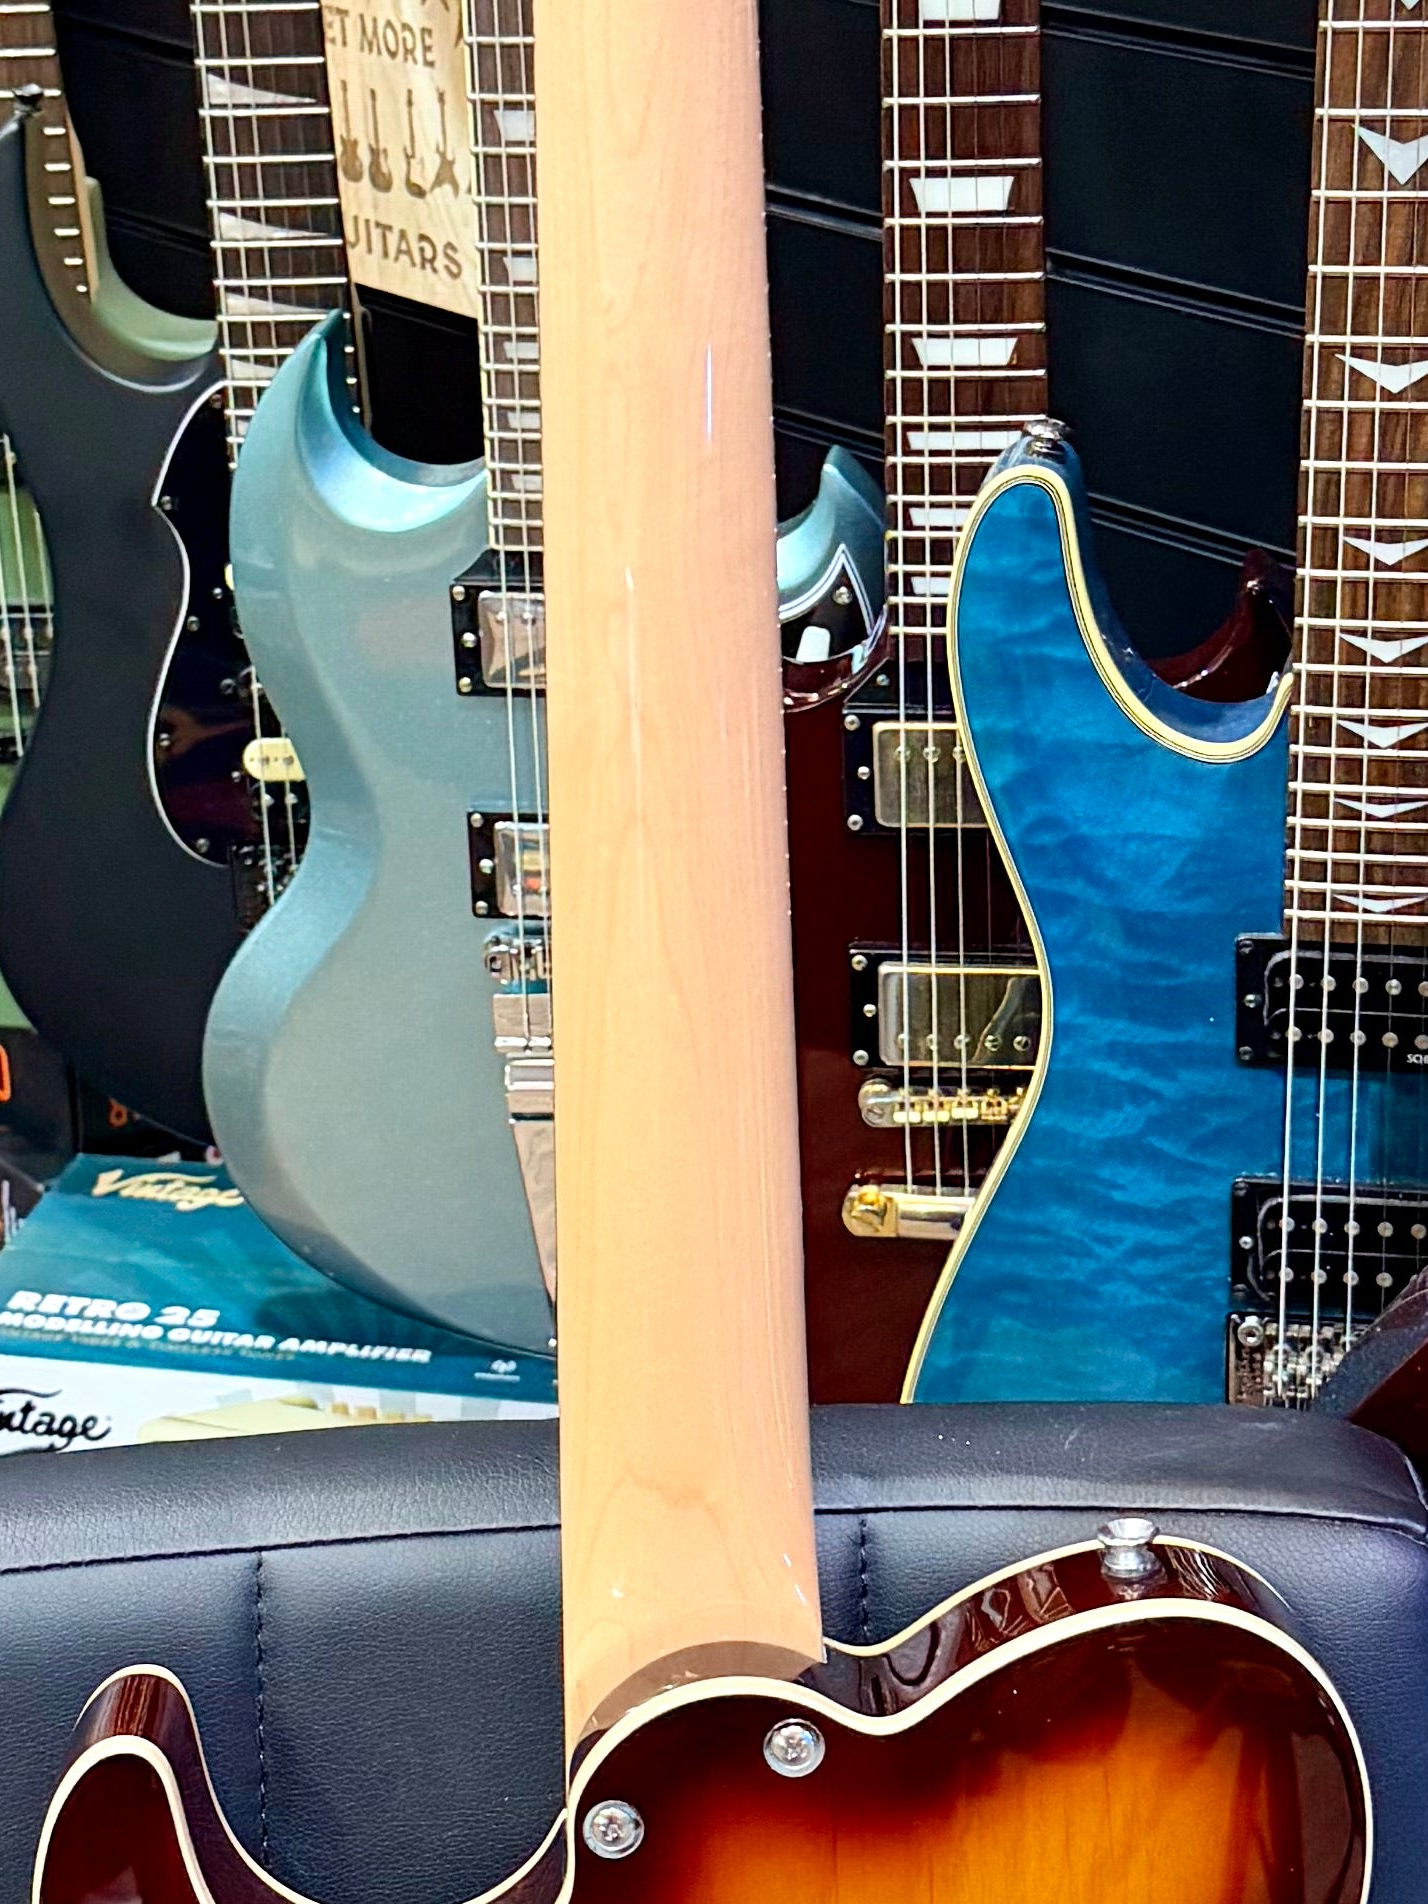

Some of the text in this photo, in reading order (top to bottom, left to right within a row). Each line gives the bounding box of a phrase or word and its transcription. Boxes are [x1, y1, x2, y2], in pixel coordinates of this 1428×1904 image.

[359, 5, 438, 71] MORE
[91, 1167, 247, 1213] Vintage
[6, 1290, 221, 1328] RETRO 25
[167, 1326, 275, 1350] GUITAR
[278, 1337, 433, 1364] AMPLIFIER
